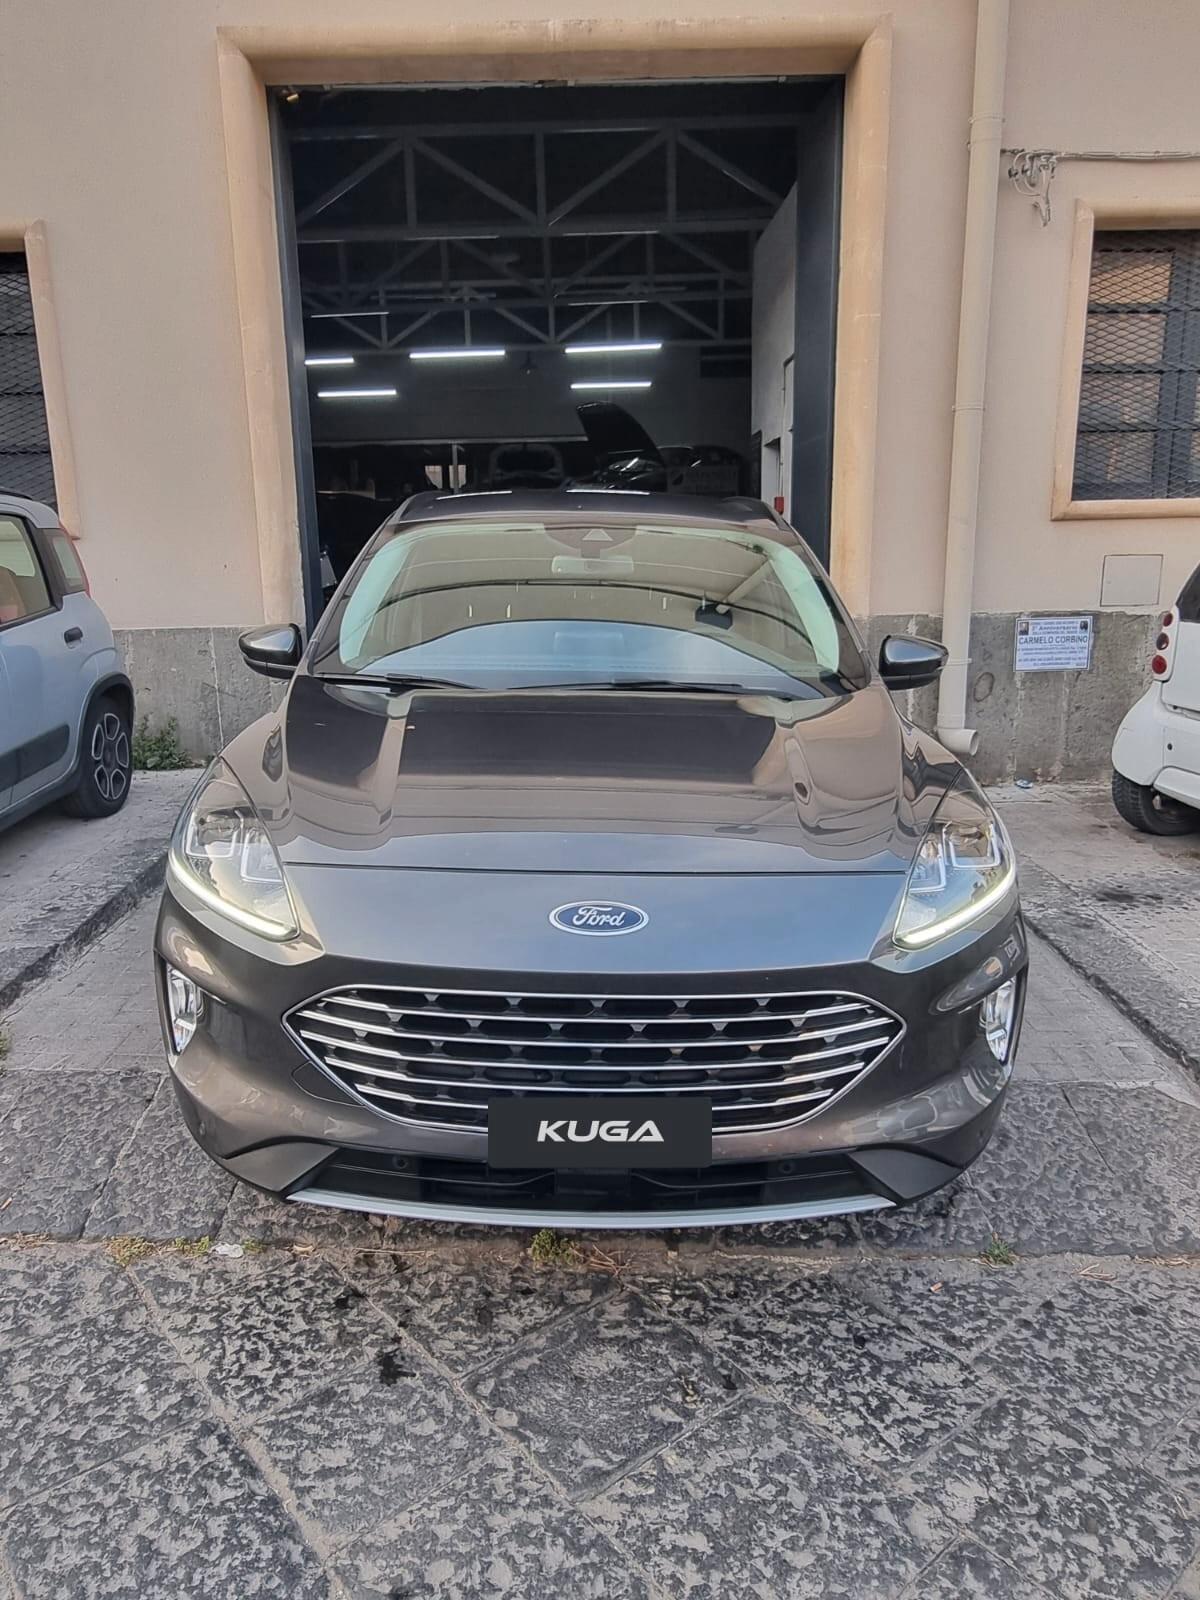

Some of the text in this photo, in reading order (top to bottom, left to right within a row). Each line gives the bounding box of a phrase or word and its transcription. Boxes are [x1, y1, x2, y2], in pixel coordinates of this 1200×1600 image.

[1018, 635, 1088, 644] CARMELO CORBINO
[572, 905, 626, 926] Ford
